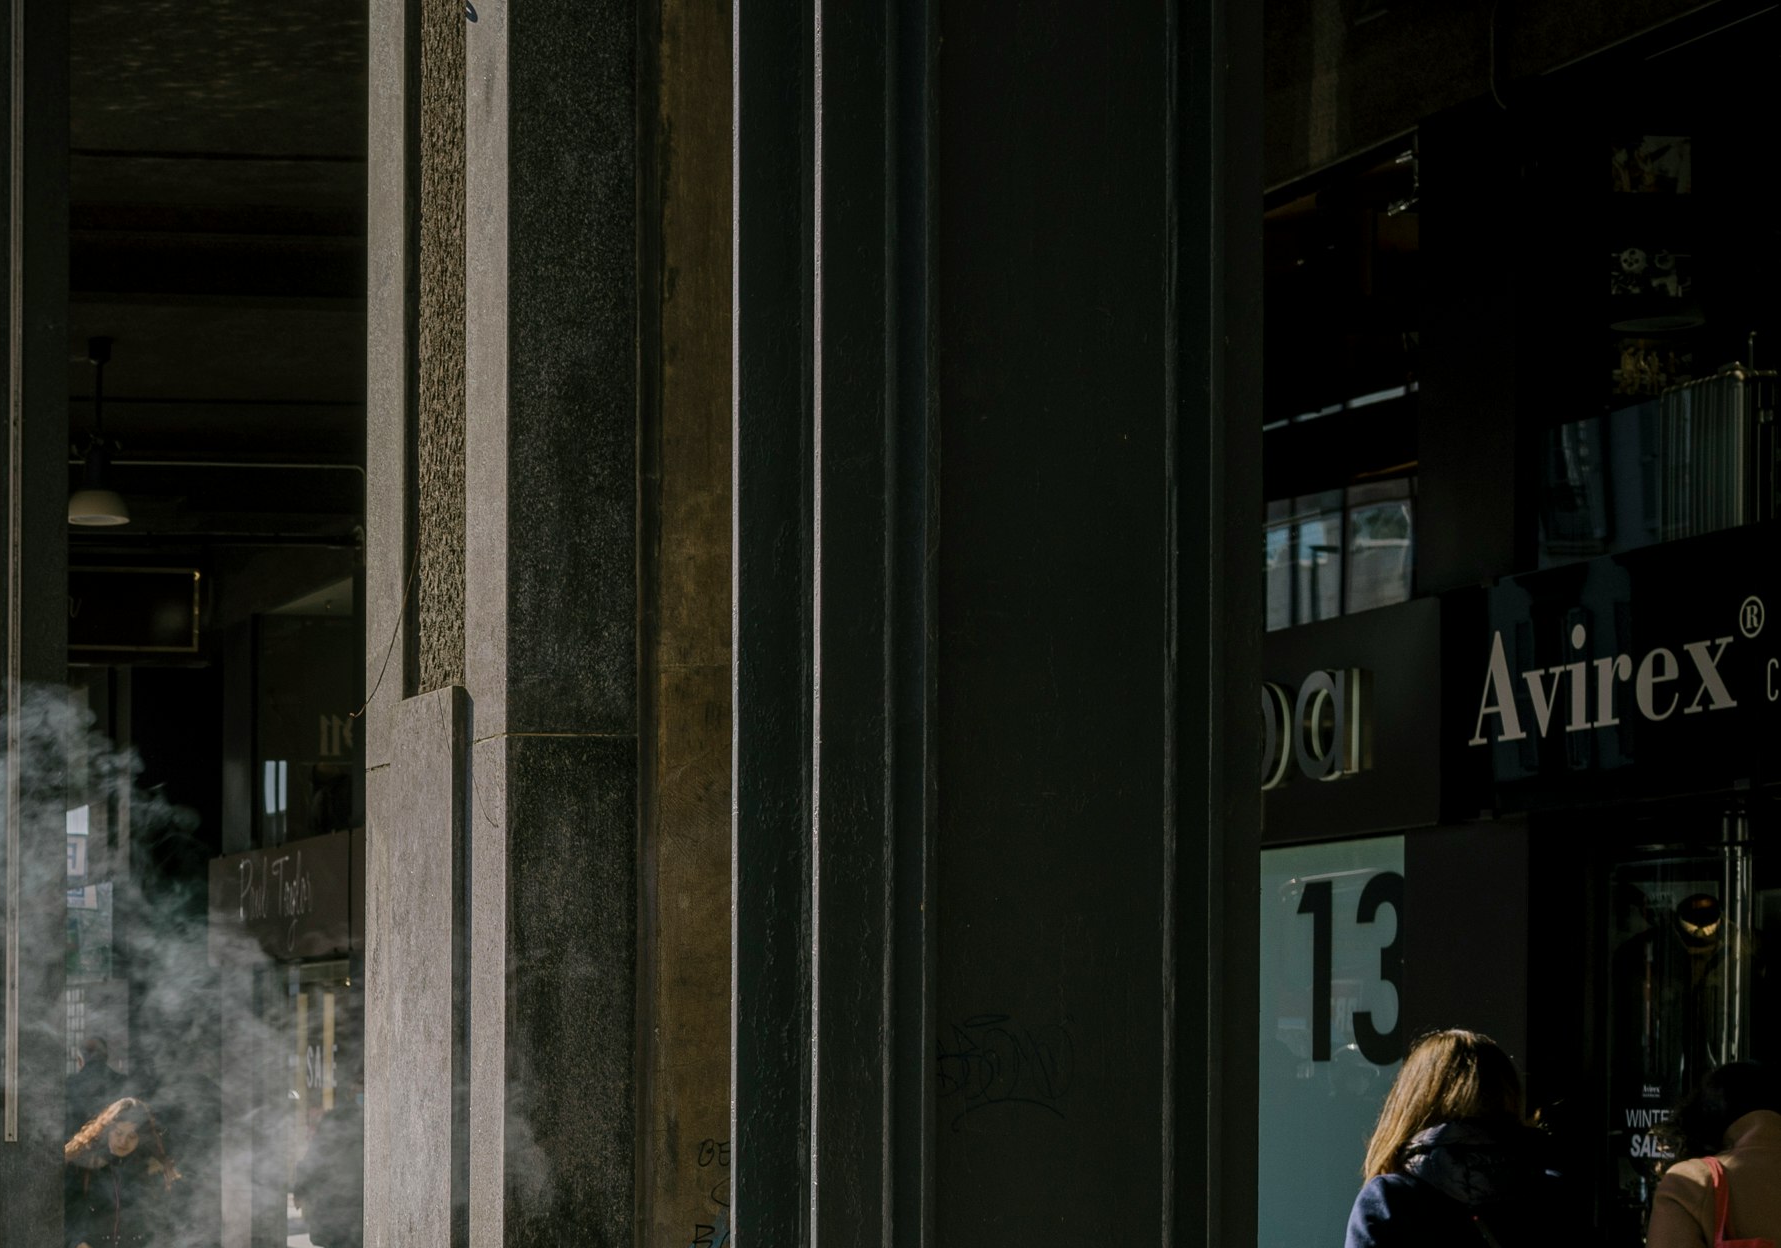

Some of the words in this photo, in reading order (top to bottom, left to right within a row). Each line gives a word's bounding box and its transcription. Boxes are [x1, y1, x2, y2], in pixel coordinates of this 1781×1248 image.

[1296, 870, 1405, 1067] 13
[306, 1045, 338, 1088] SALE
[1625, 1108, 1674, 1129] WINTE
